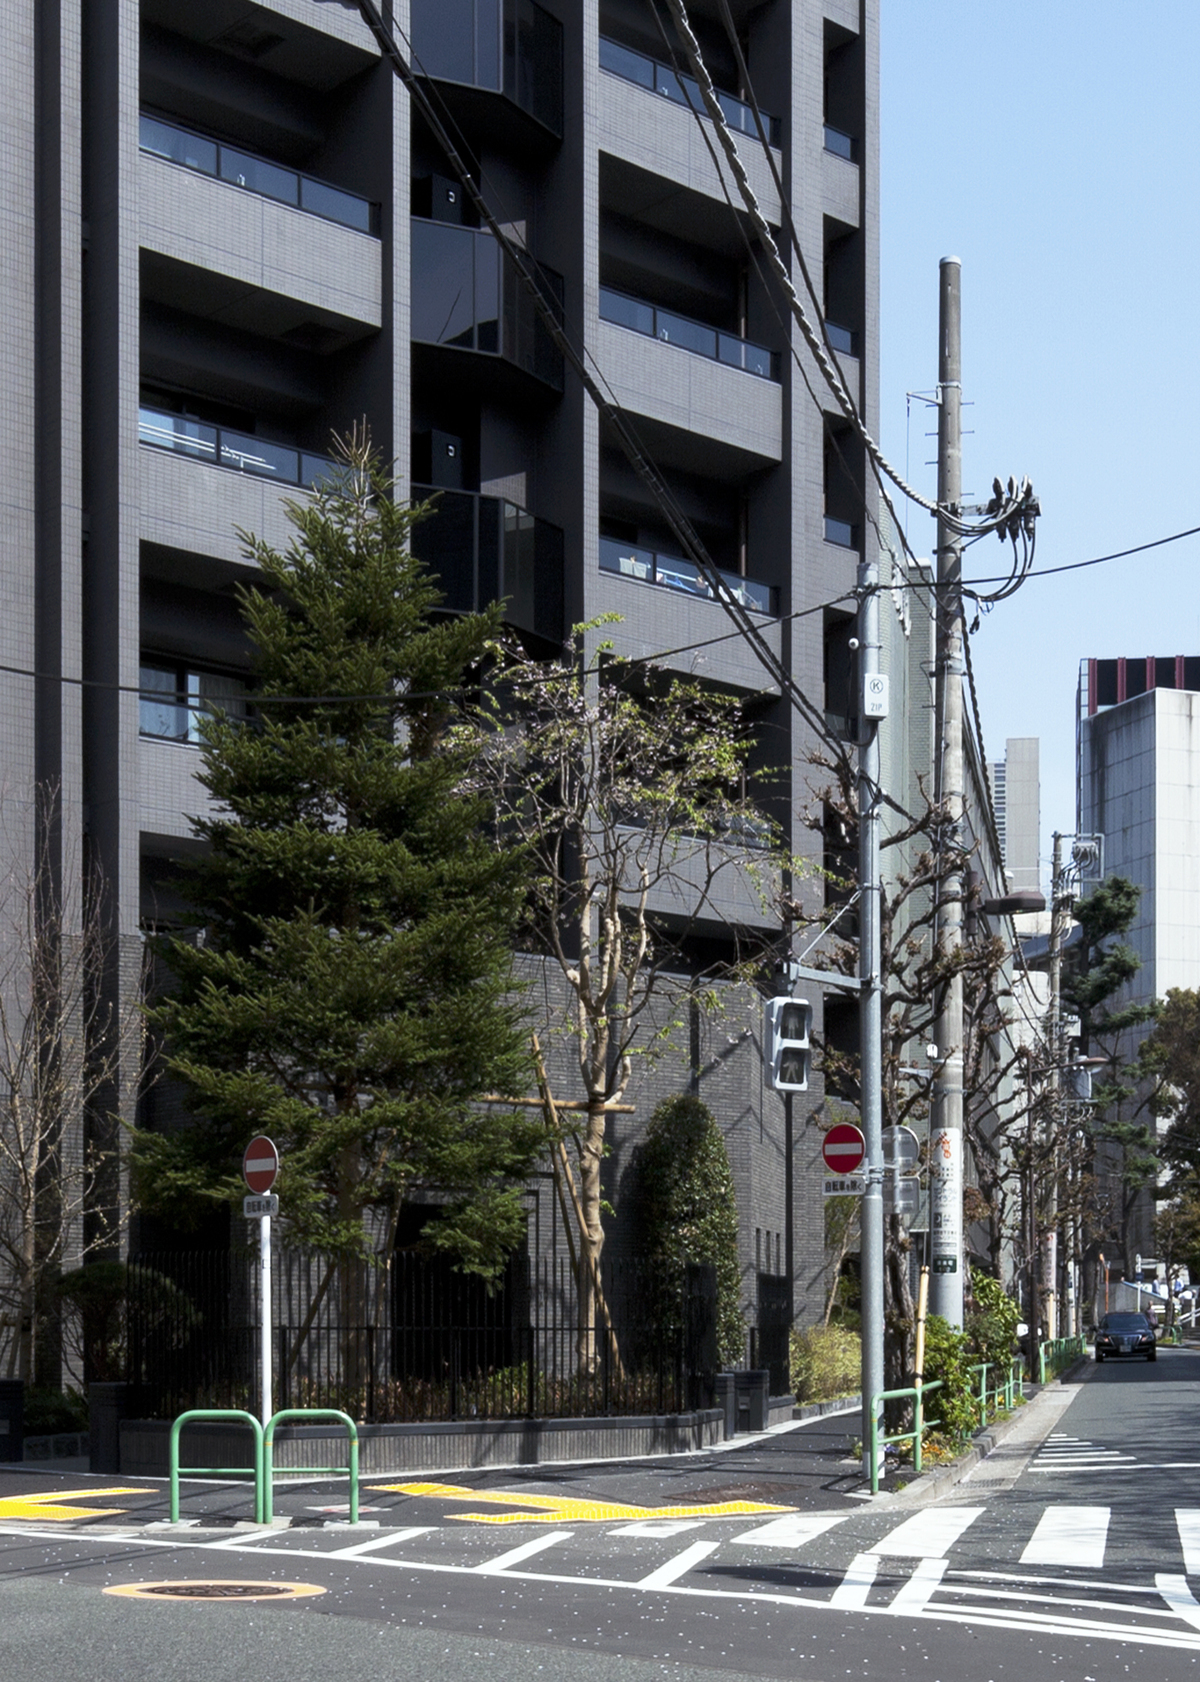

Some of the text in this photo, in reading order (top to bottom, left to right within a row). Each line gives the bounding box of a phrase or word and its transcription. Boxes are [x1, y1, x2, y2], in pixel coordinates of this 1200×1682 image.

[824, 1179, 863, 1193] 自転車を除く
